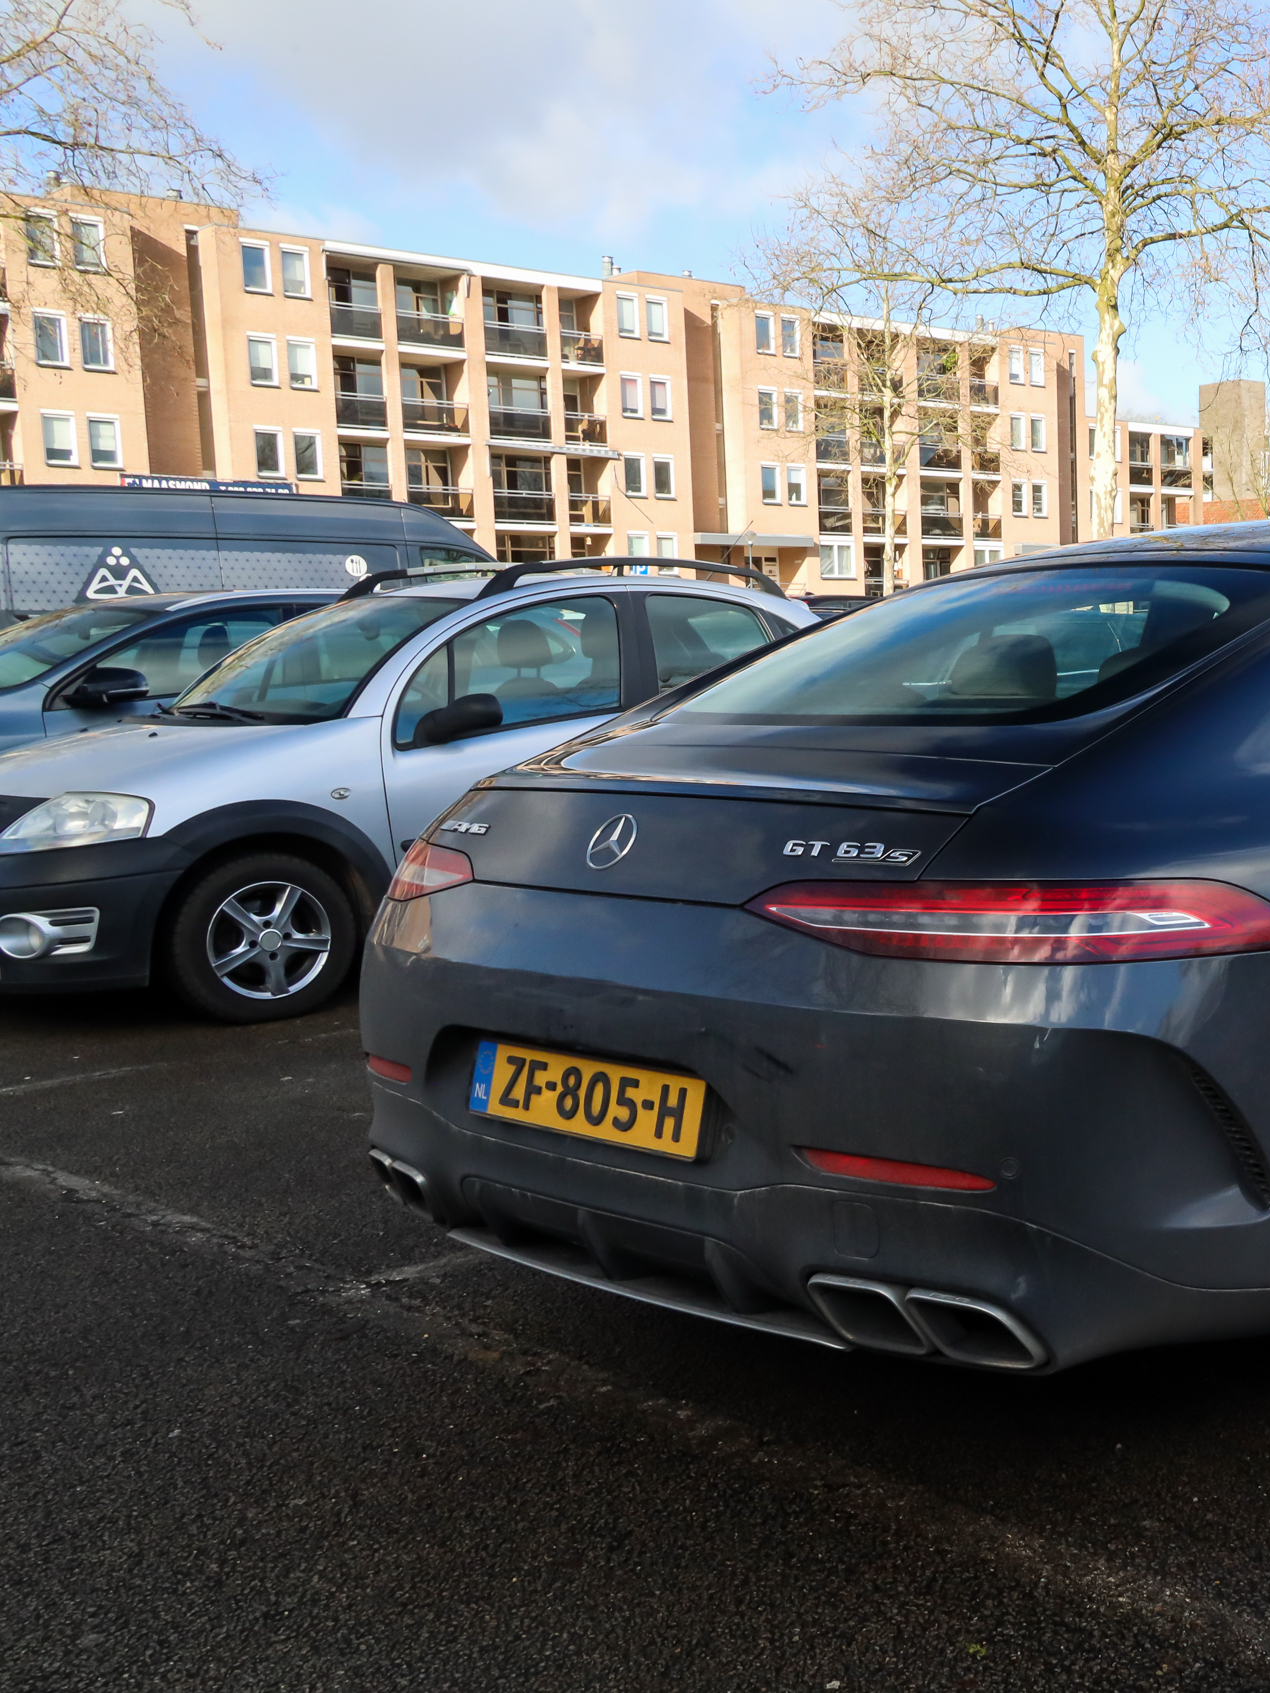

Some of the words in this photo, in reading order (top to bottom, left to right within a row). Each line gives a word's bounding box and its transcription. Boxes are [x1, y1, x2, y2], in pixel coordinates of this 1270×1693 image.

[783, 840, 831, 857] GT
[474, 1082, 488, 1100] NL
[499, 1055, 688, 1143] ZF-805-H
